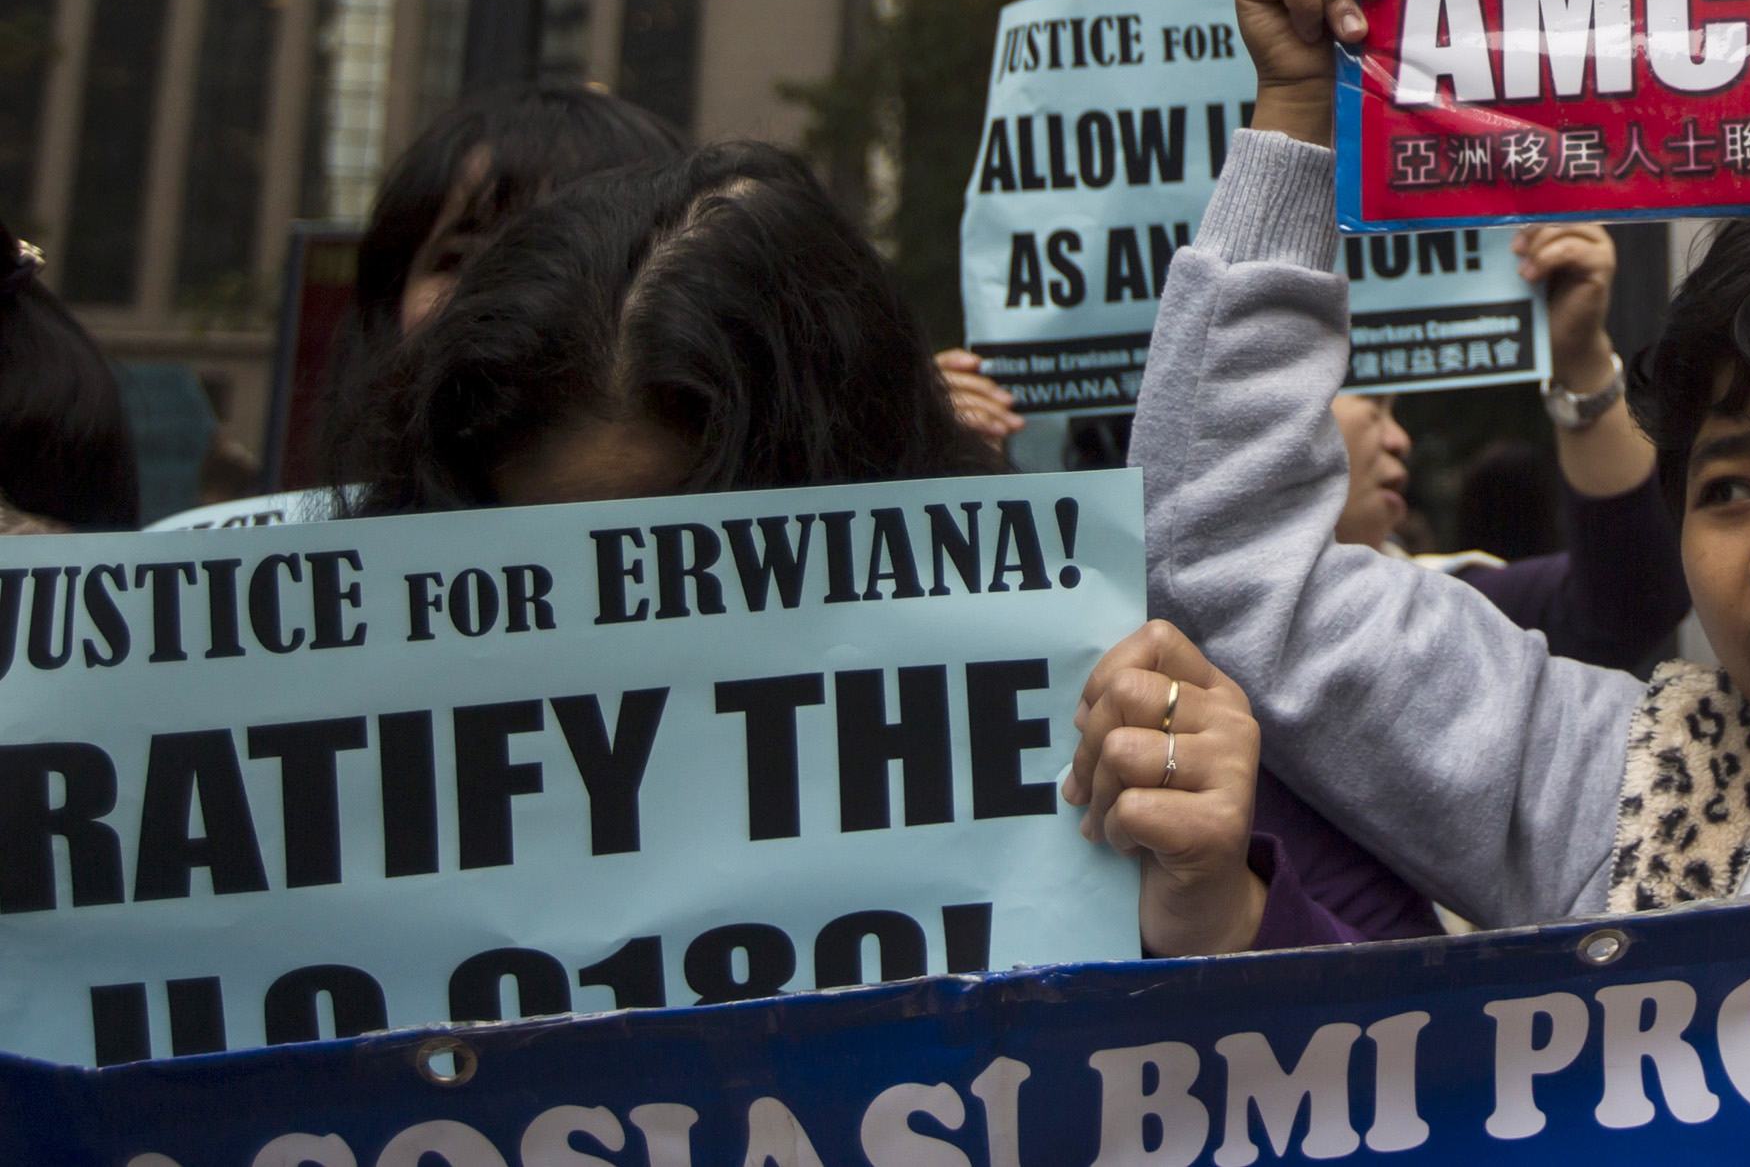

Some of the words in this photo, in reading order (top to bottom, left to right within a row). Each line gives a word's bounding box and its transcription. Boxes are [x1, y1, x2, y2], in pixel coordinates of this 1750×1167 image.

[998, 14, 1144, 83] JUSTICE
[1162, 24, 1235, 62] FOR
[980, 106, 1186, 192] ALLOW
[1006, 229, 1086, 308] AS
[0, 549, 367, 680] JUSTICE
[404, 564, 557, 642] FOR
[589, 496, 1082, 625] ERWIANA!
[0, 686, 670, 915] RATIFY
[714, 658, 1057, 841] THE
[1088, 1011, 1430, 1167] BMI
